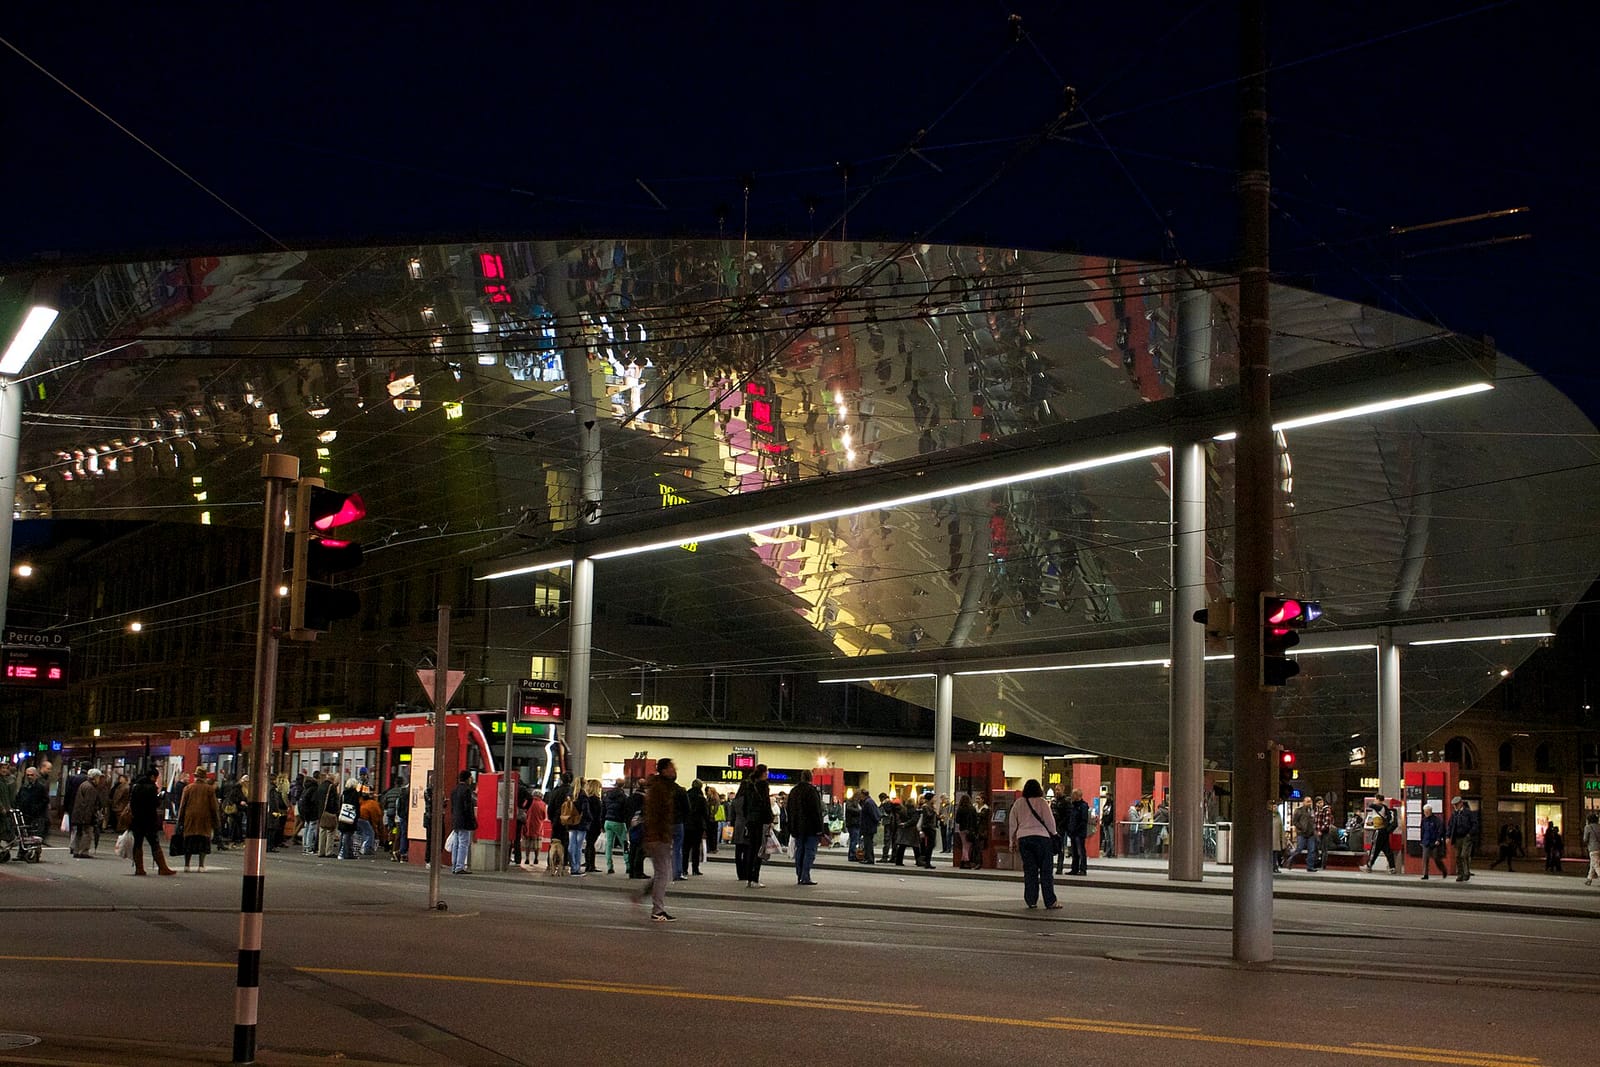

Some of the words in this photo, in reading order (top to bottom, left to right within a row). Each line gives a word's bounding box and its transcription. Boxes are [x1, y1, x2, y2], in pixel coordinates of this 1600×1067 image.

[9, 631, 49, 643] Perron
[54, 634, 62, 644] D
[523, 679, 550, 689] Perron
[552, 681, 558, 689] C
[636, 704, 670, 721] LOEB
[491, 721, 499, 733] 9
[1256, 752, 1266, 760] 10
[721, 770, 743, 780] LOEB
[1511, 782, 1555, 794] LEBENSMITTEL
